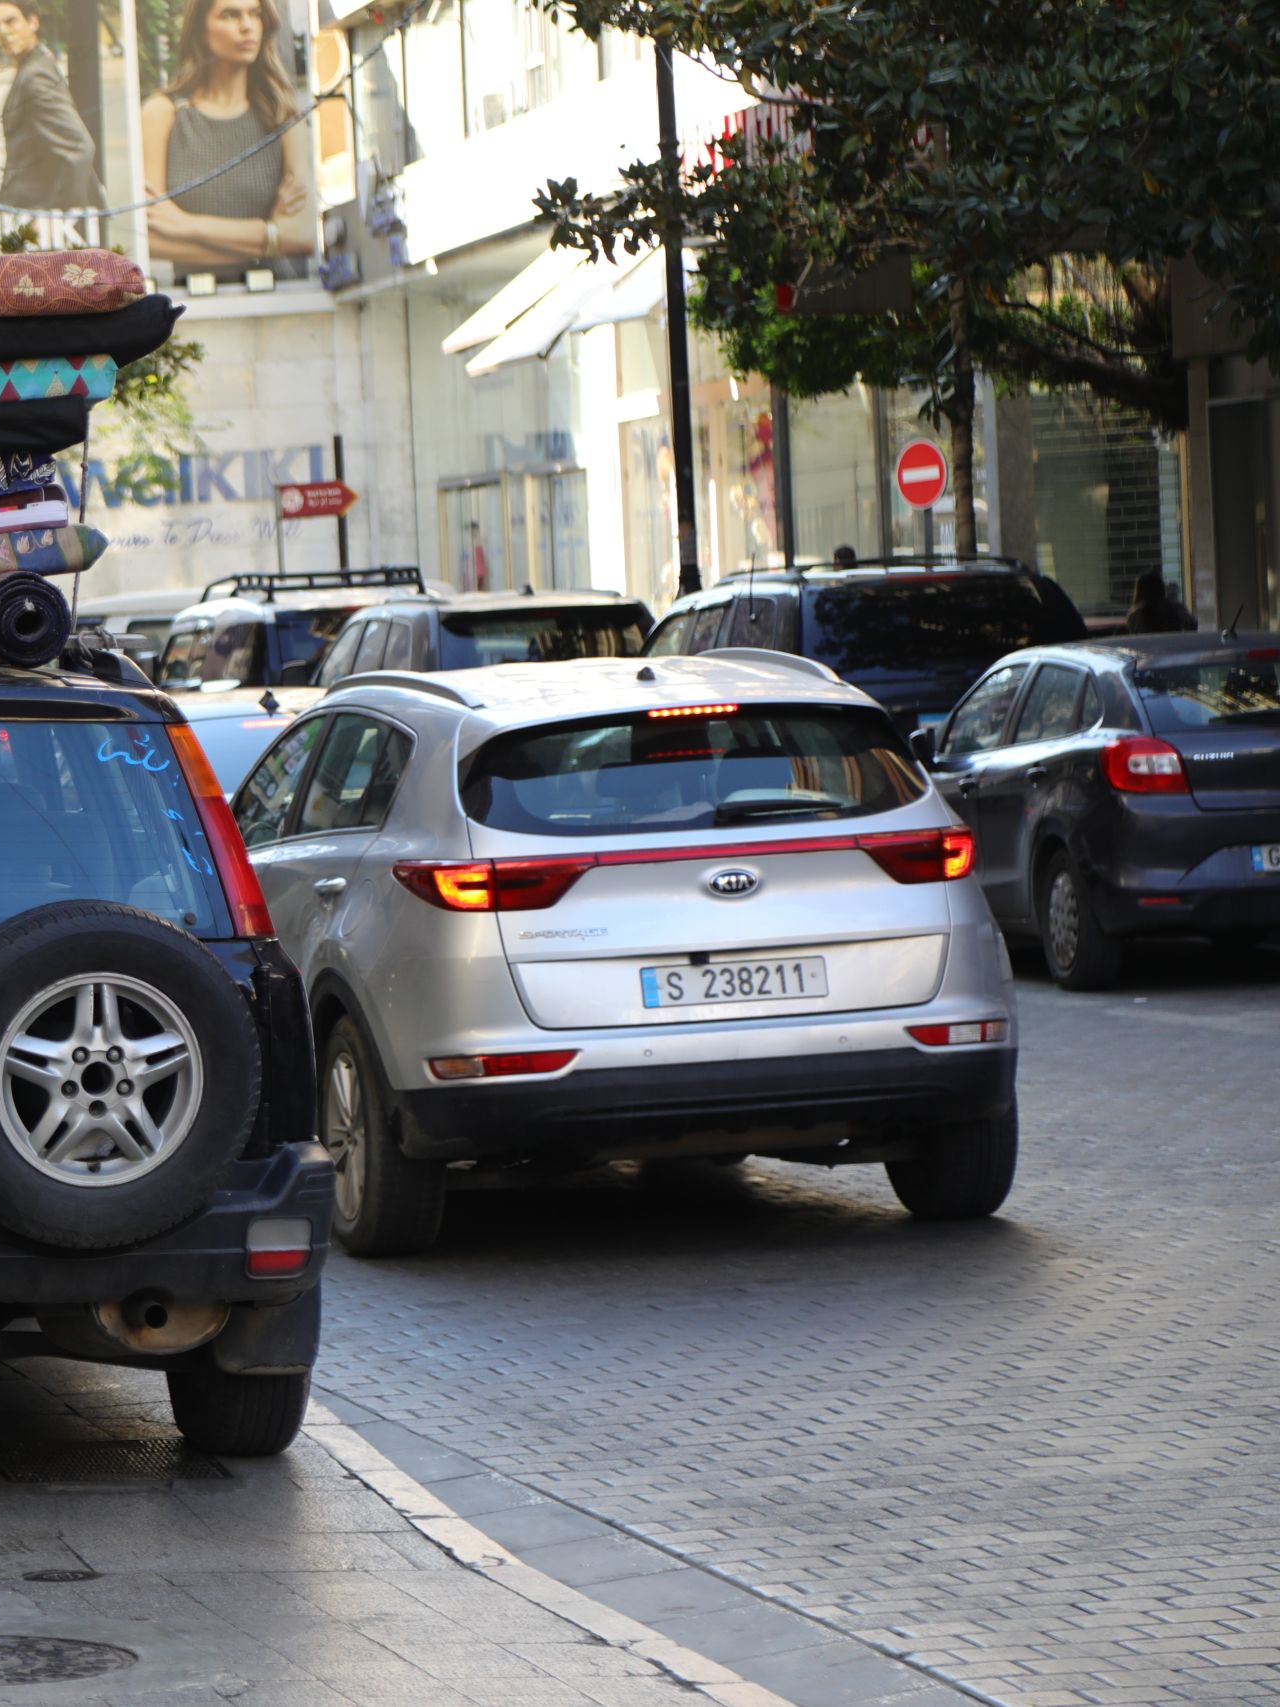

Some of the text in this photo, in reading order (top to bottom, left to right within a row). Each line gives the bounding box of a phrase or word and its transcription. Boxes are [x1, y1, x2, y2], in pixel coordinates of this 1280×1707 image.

[717, 874, 750, 890] KIA
[666, 963, 805, 1001] S 238211
